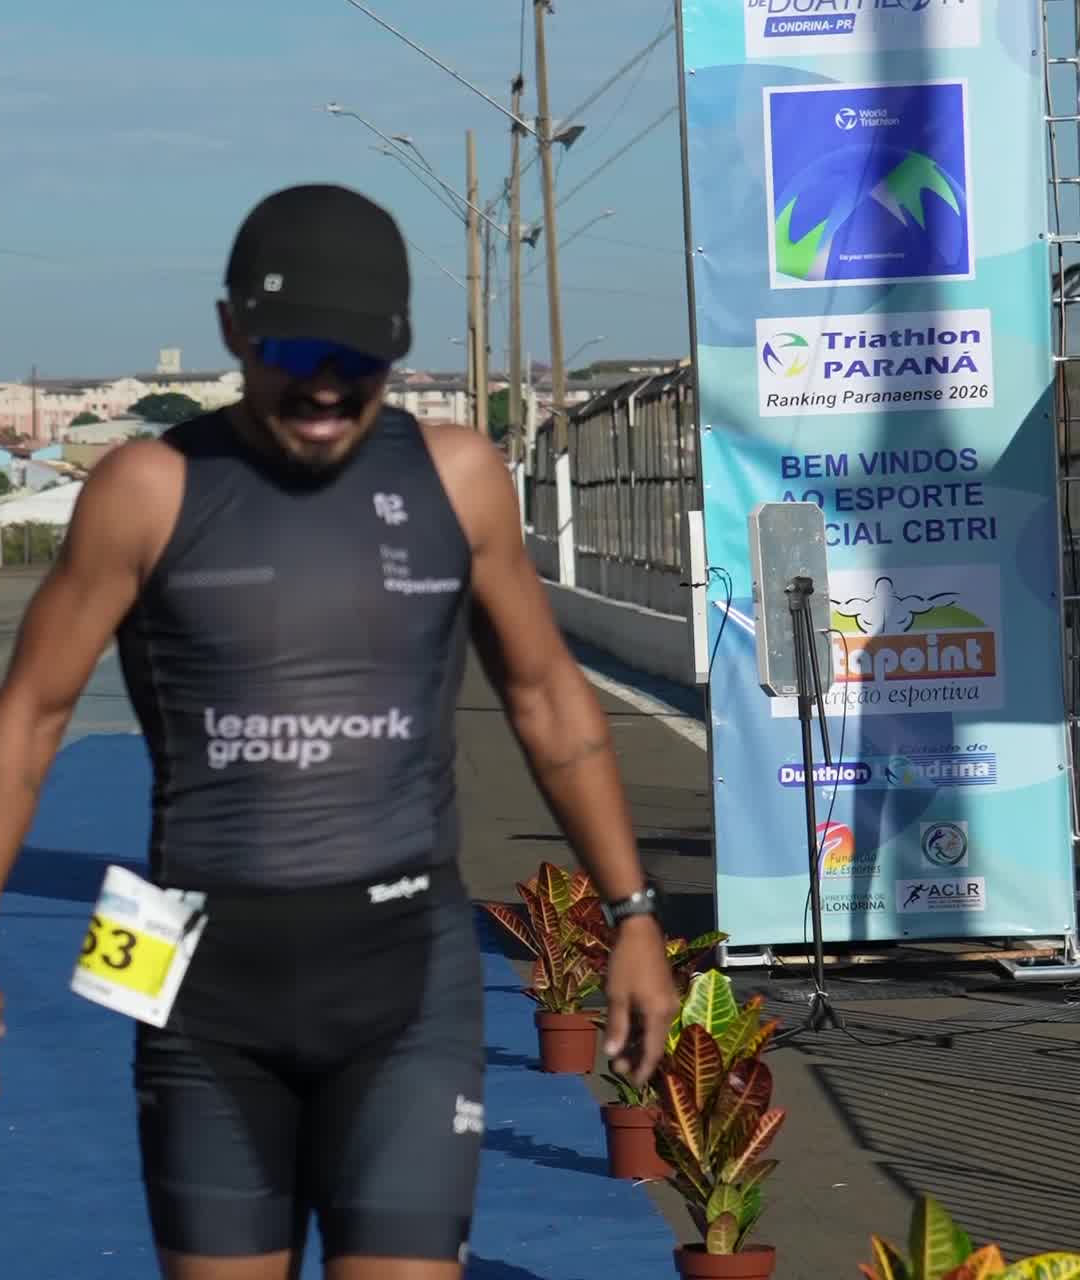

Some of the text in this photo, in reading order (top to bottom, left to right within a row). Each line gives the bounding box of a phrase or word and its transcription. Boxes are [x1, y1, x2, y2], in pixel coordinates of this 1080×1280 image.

[836, 19, 851, 30] PR
[822, 328, 981, 350] Triathlon
[824, 352, 978, 379] PARANÁ
[766, 385, 988, 408] Ranking Paranaense 2026
[781, 448, 978, 479] BEM VINDOS
[835, 482, 983, 512] ESPORTE
[825, 517, 996, 546] CIAL CBTRI
[888, 683, 980, 707] esportiva
[205, 708, 413, 739] leanwork
[207, 737, 332, 769] group
[966, 743, 988, 751] de
[928, 883, 979, 896] ACLR
[826, 901, 885, 912] LONDRINA
